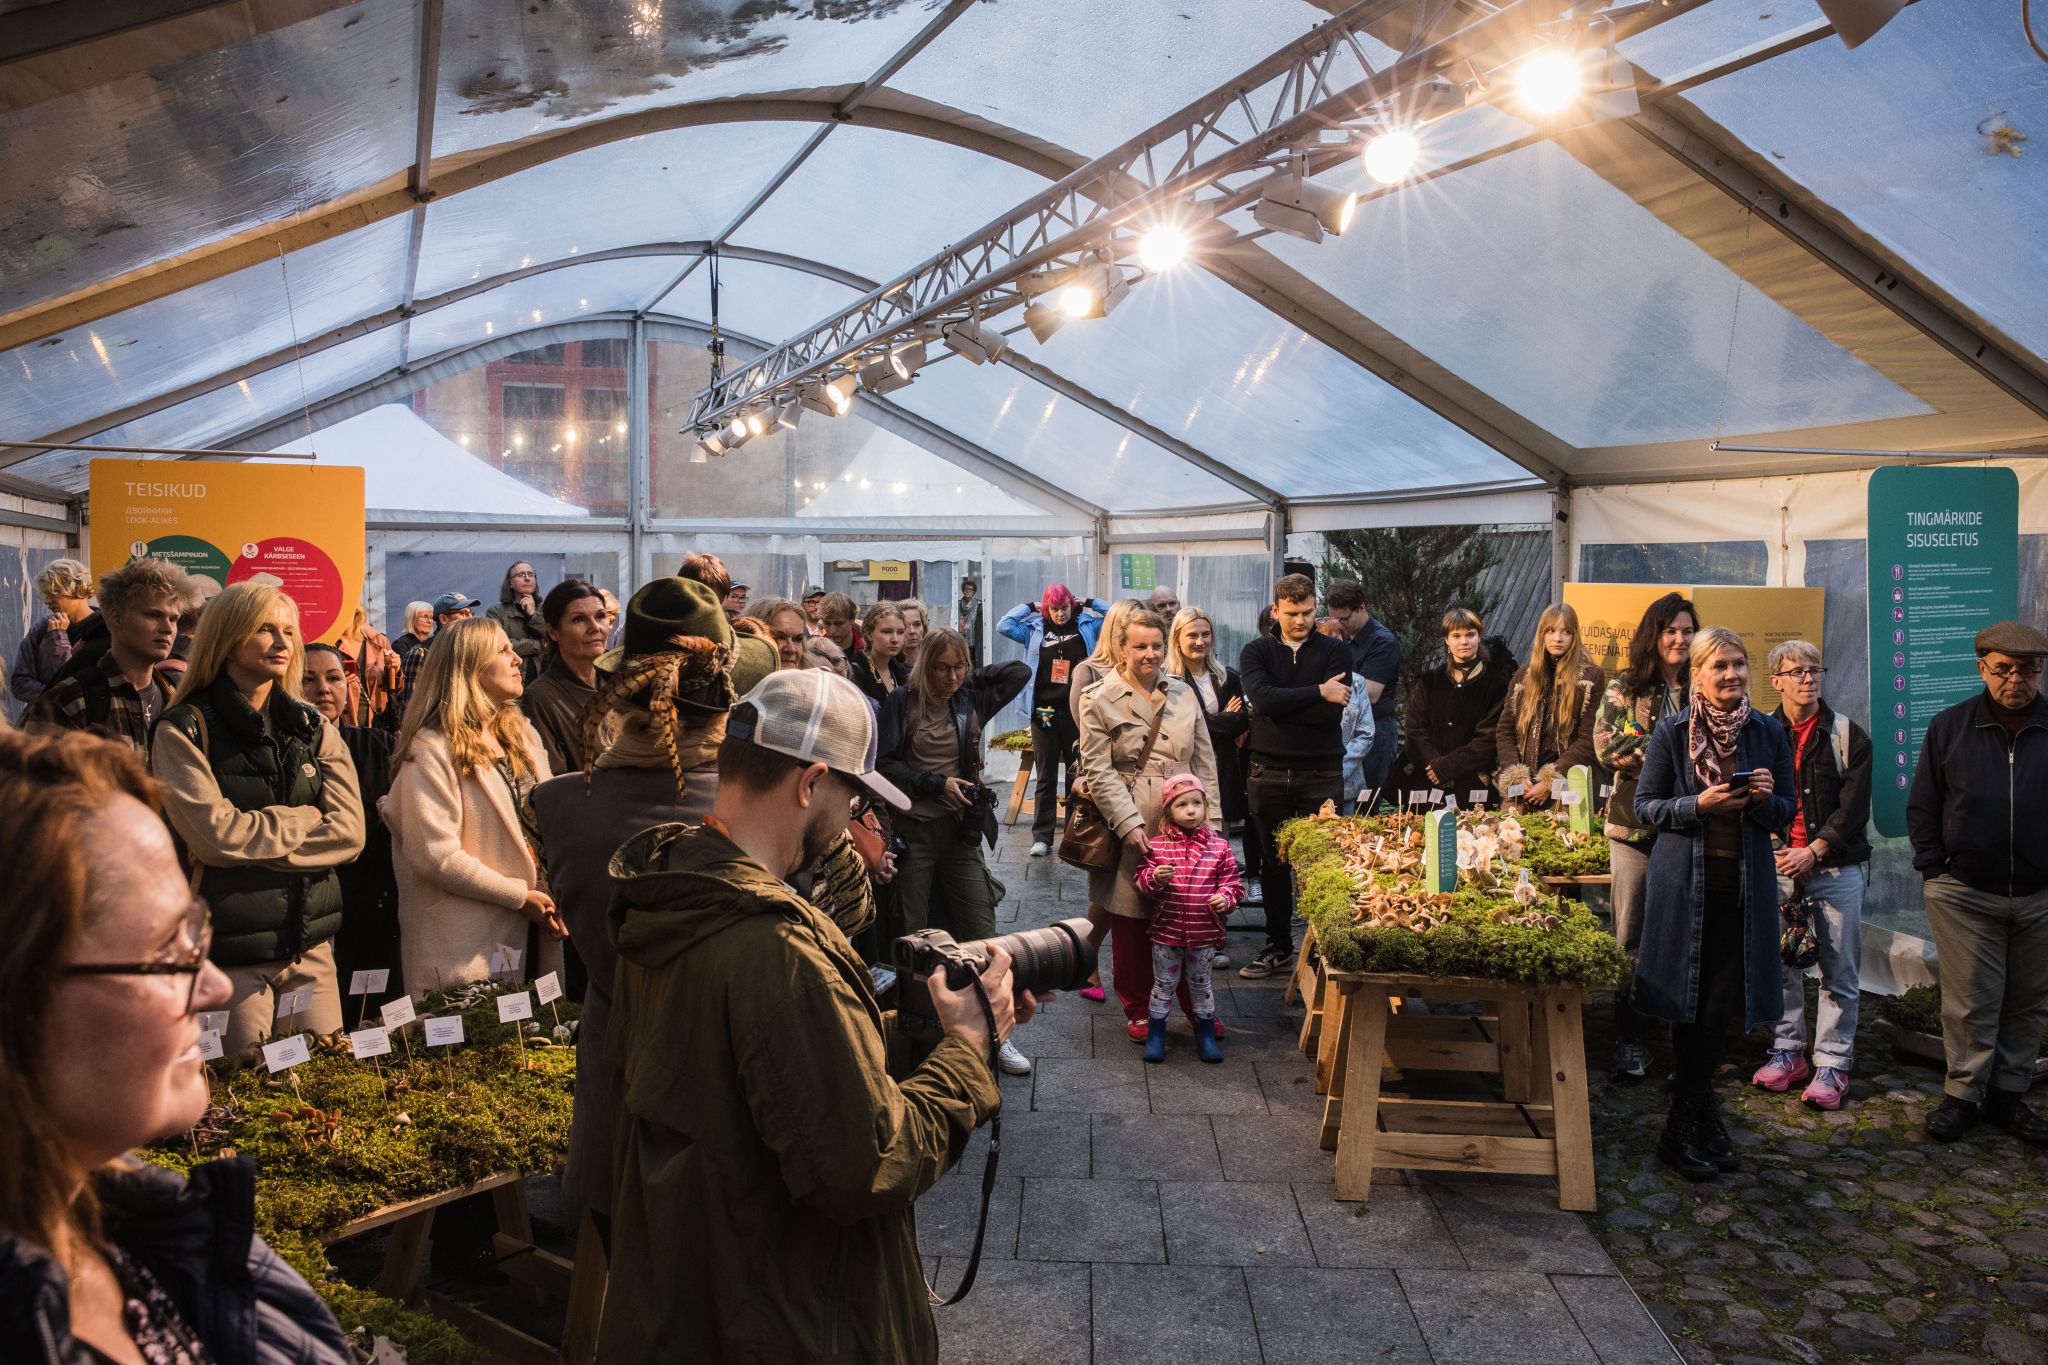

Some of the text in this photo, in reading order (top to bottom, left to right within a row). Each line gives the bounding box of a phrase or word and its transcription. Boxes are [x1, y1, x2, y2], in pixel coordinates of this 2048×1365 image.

[124, 482, 206, 498] TEISIKUD
[125, 506, 173, 515] ДВОЙНИКИ
[125, 517, 178, 525] LOOK-ALIKES
[1907, 509, 1983, 526] TINGMÄRKIDE
[1906, 532, 1979, 547] SISUSELETUS
[151, 550, 208, 558] METSŠAMPINJON
[264, 552, 306, 560] KÄRBSESEEN
